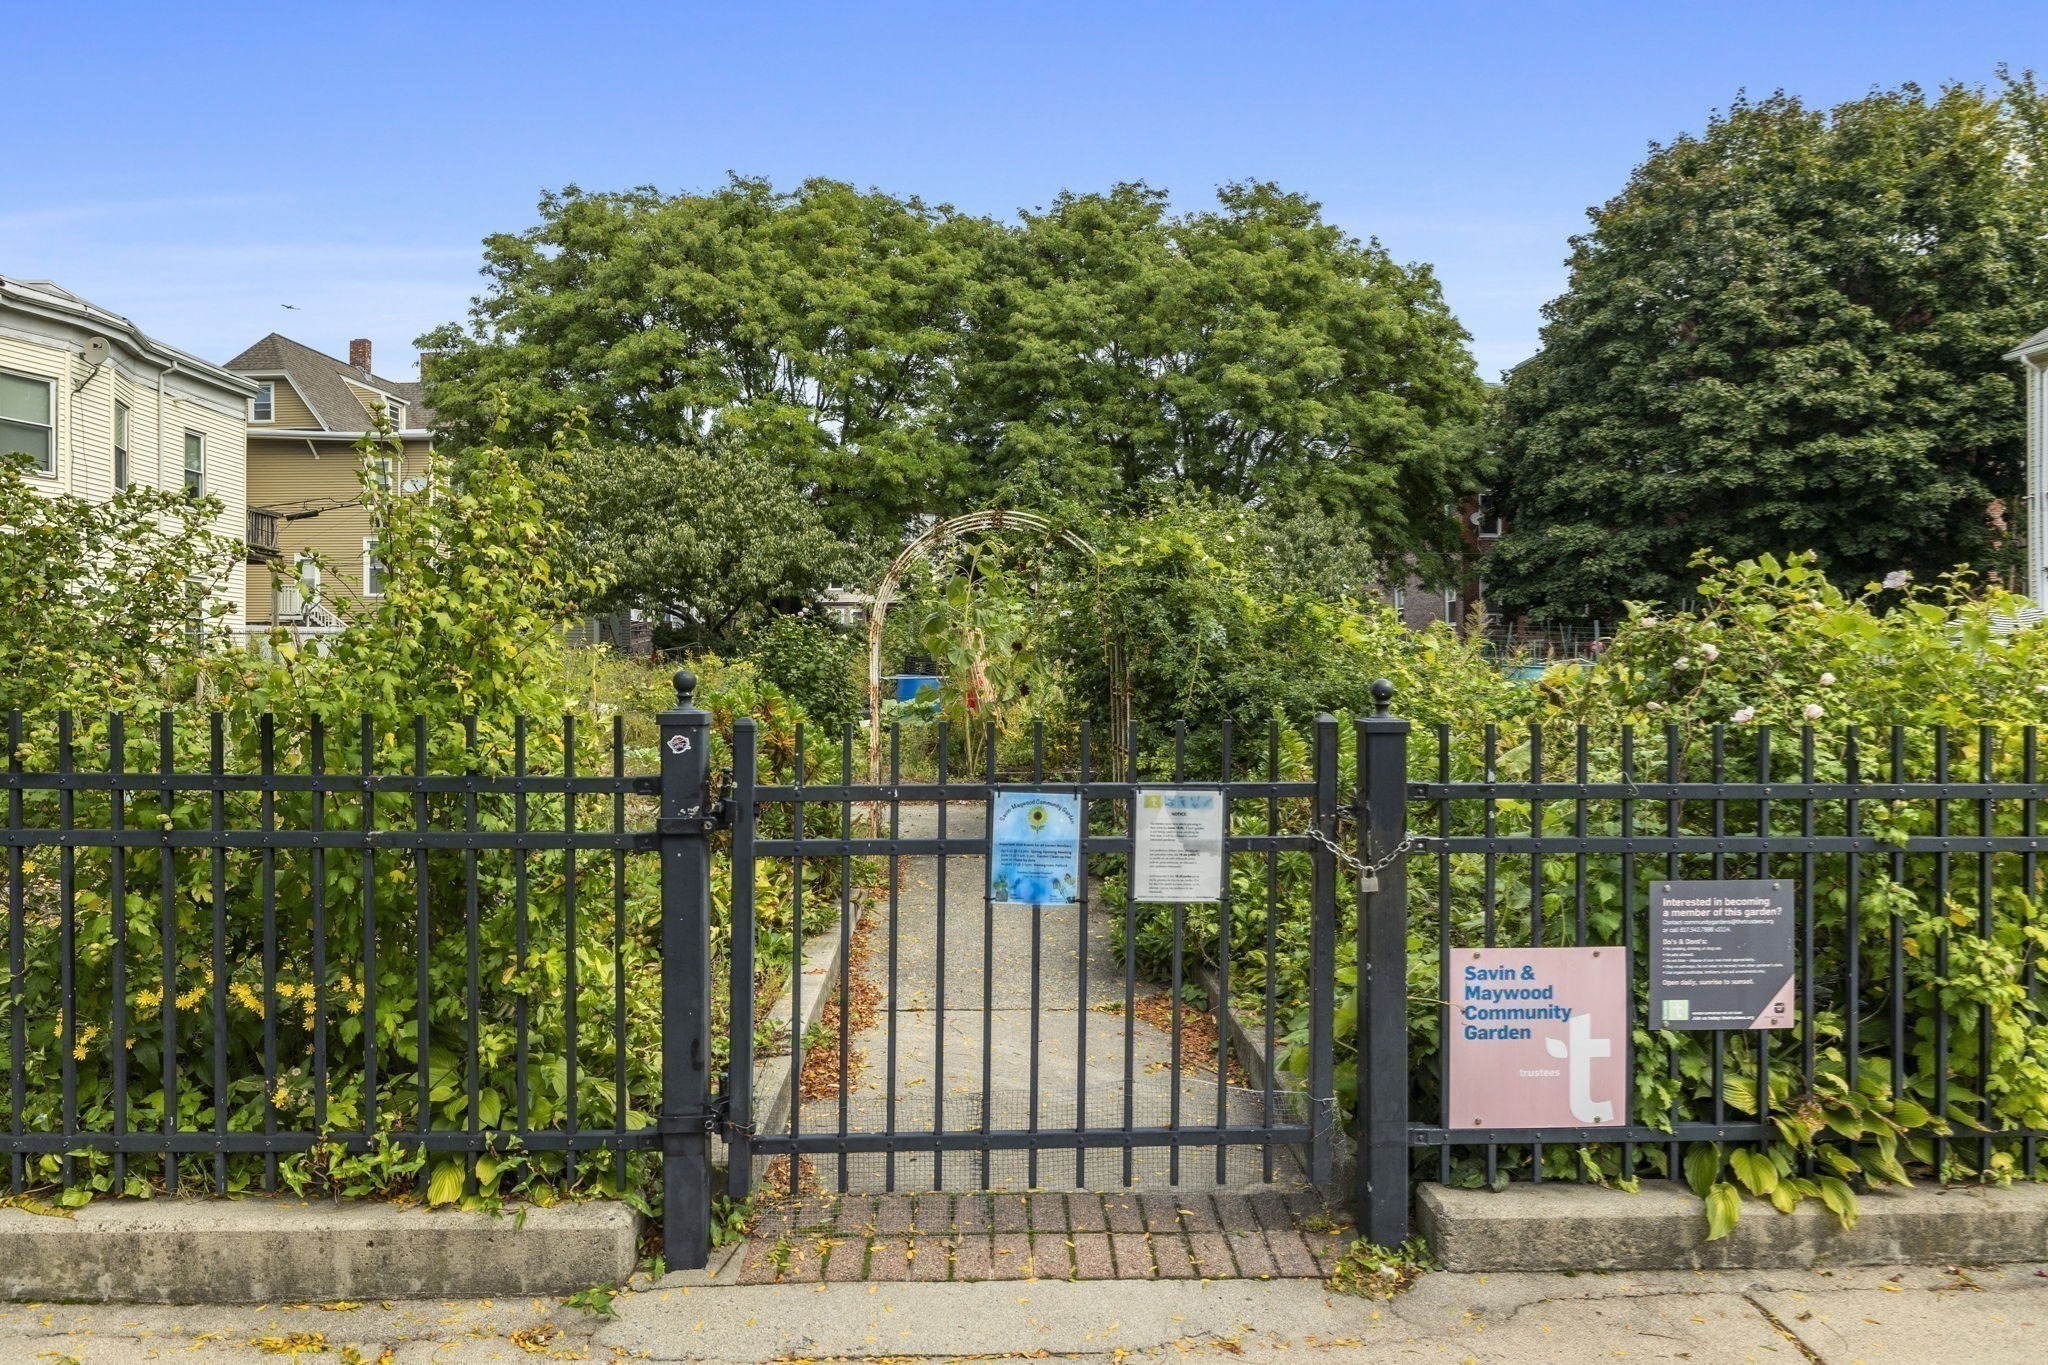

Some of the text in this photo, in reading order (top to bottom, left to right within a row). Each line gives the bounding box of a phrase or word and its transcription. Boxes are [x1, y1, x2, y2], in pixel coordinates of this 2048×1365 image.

[1035, 798, 1062, 811] Community
[1662, 897, 1770, 907] Interested in becoming
[1671, 908, 1711, 917] member
[1713, 908, 1722, 916] of
[1724, 907, 1742, 916] this
[1744, 907, 1783, 917] garden?
[1464, 965, 1535, 981] Savin &
[1464, 985, 1553, 1003] Maywood
[1464, 1004, 1572, 1023] Community
[1464, 1025, 1531, 1040] Garden
[1519, 1068, 1560, 1077] trustees
